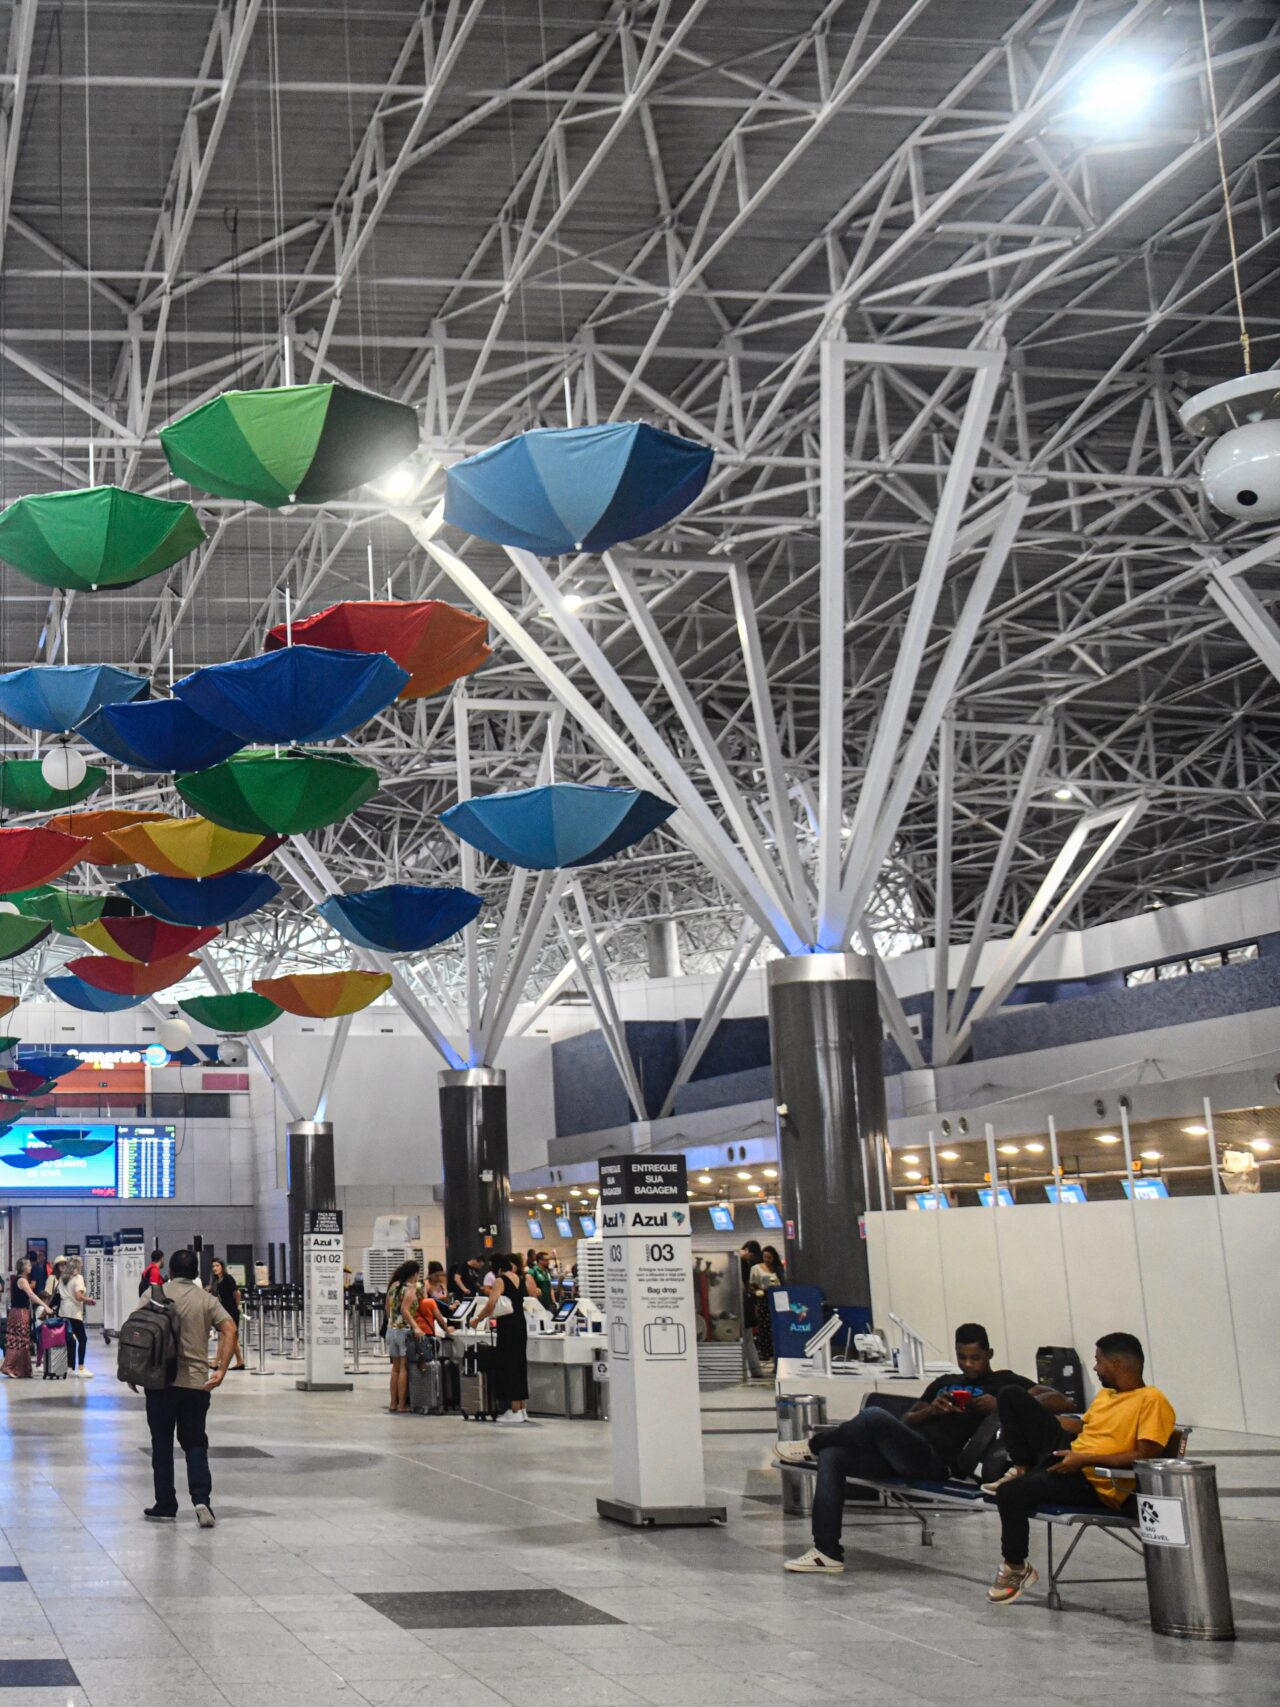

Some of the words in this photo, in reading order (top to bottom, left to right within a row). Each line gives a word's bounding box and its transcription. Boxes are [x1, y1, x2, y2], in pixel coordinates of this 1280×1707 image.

[631, 1164, 678, 1172] ENTREGUE
[645, 1175, 664, 1183] SUA
[634, 1186, 678, 1195] BAGAGEM
[632, 1212, 668, 1227] Azul
[650, 1244, 674, 1262] 03
[316, 1254, 326, 1263] 01
[329, 1254, 341, 1263] 02
[647, 1287, 661, 1295] Bag
[661, 1287, 677, 1295] drop
[790, 1323, 811, 1332] Azul
